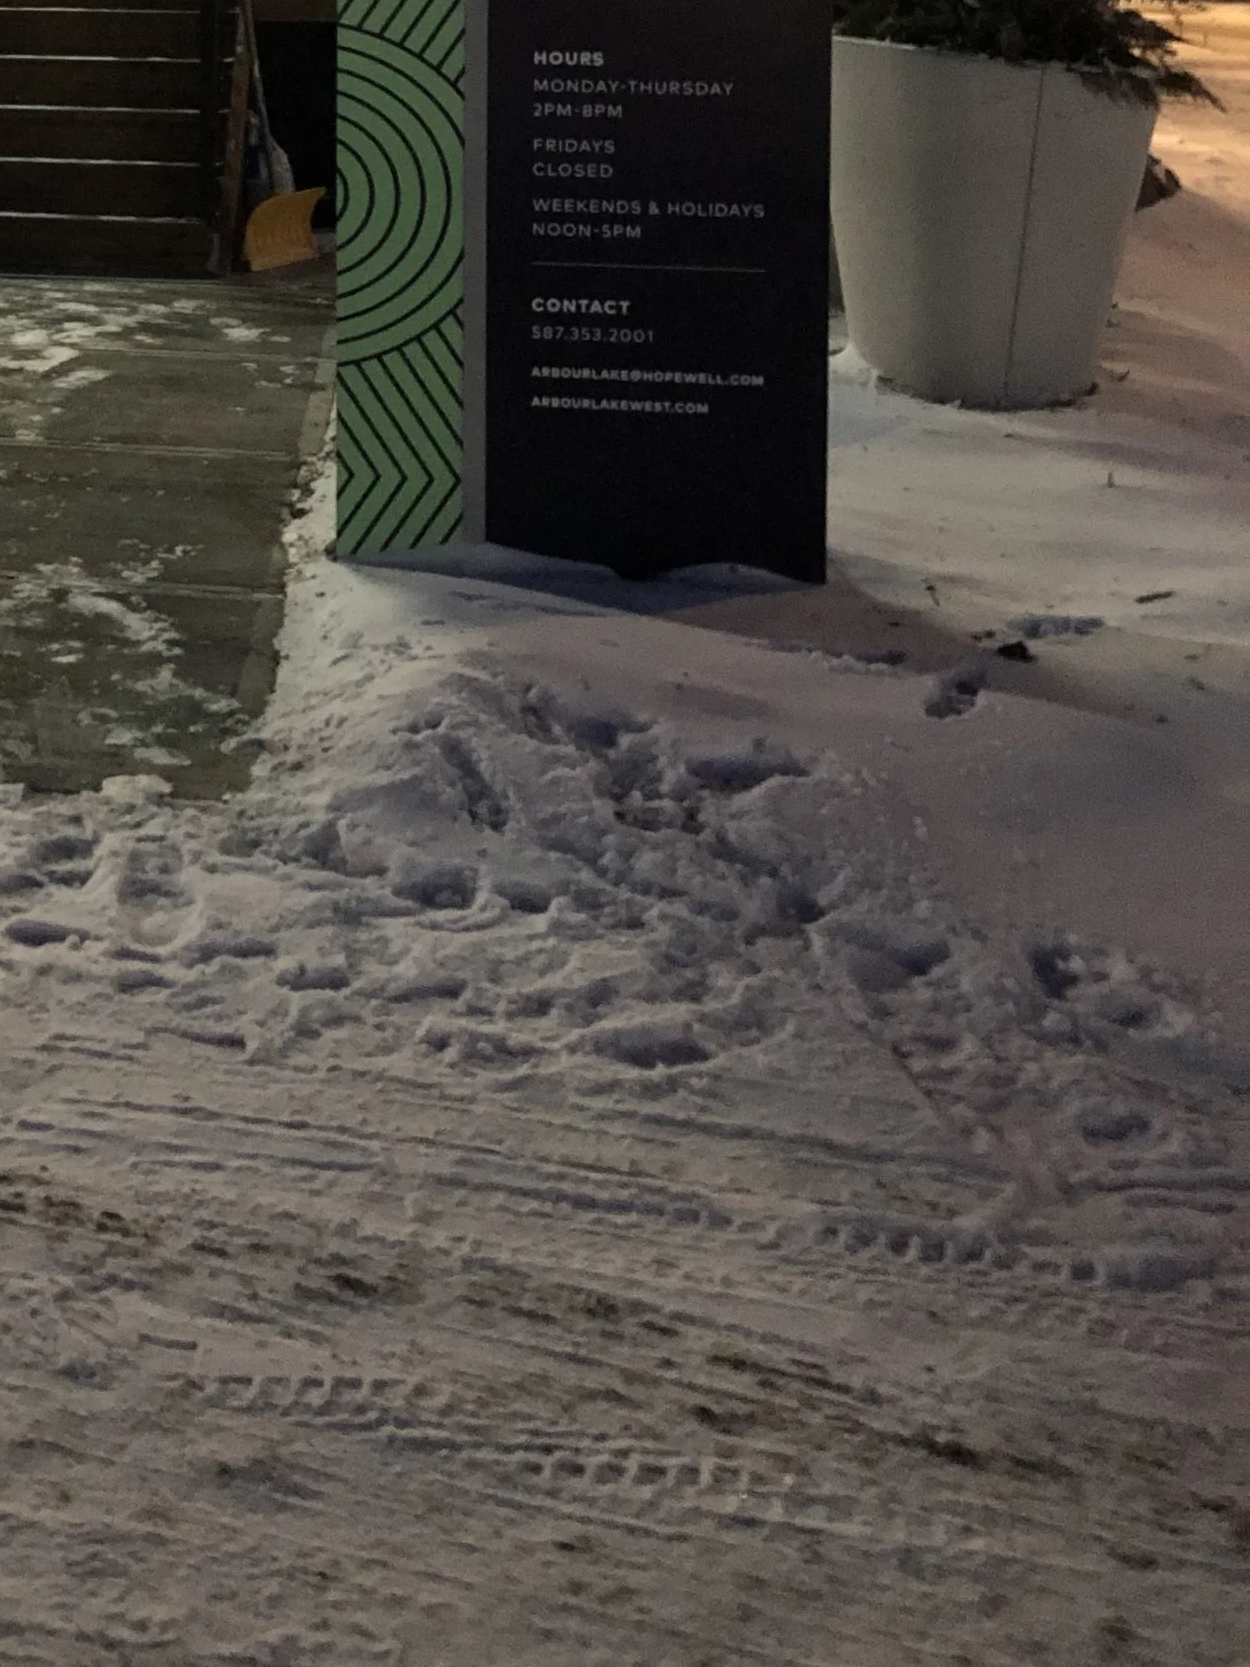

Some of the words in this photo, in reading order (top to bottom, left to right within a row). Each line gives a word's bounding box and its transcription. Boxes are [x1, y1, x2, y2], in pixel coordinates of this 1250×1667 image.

[533, 51, 605, 66] HOURS
[533, 79, 734, 96] MONDAY-THURSDAY
[533, 138, 616, 154] FRIDAYS
[533, 162, 613, 178] CLOSED
[533, 198, 642, 215] WEEKENDS
[649, 201, 660, 215] &
[668, 202, 765, 218] HOLIDAYS
[531, 298, 631, 315] CONTACT
[531, 326, 654, 343] 587.353.2001
[531, 366, 765, 386] ARBOURLAKE@HOPEWELL.COM
[531, 396, 709, 414] ARBOURLAKEWEST.COM
